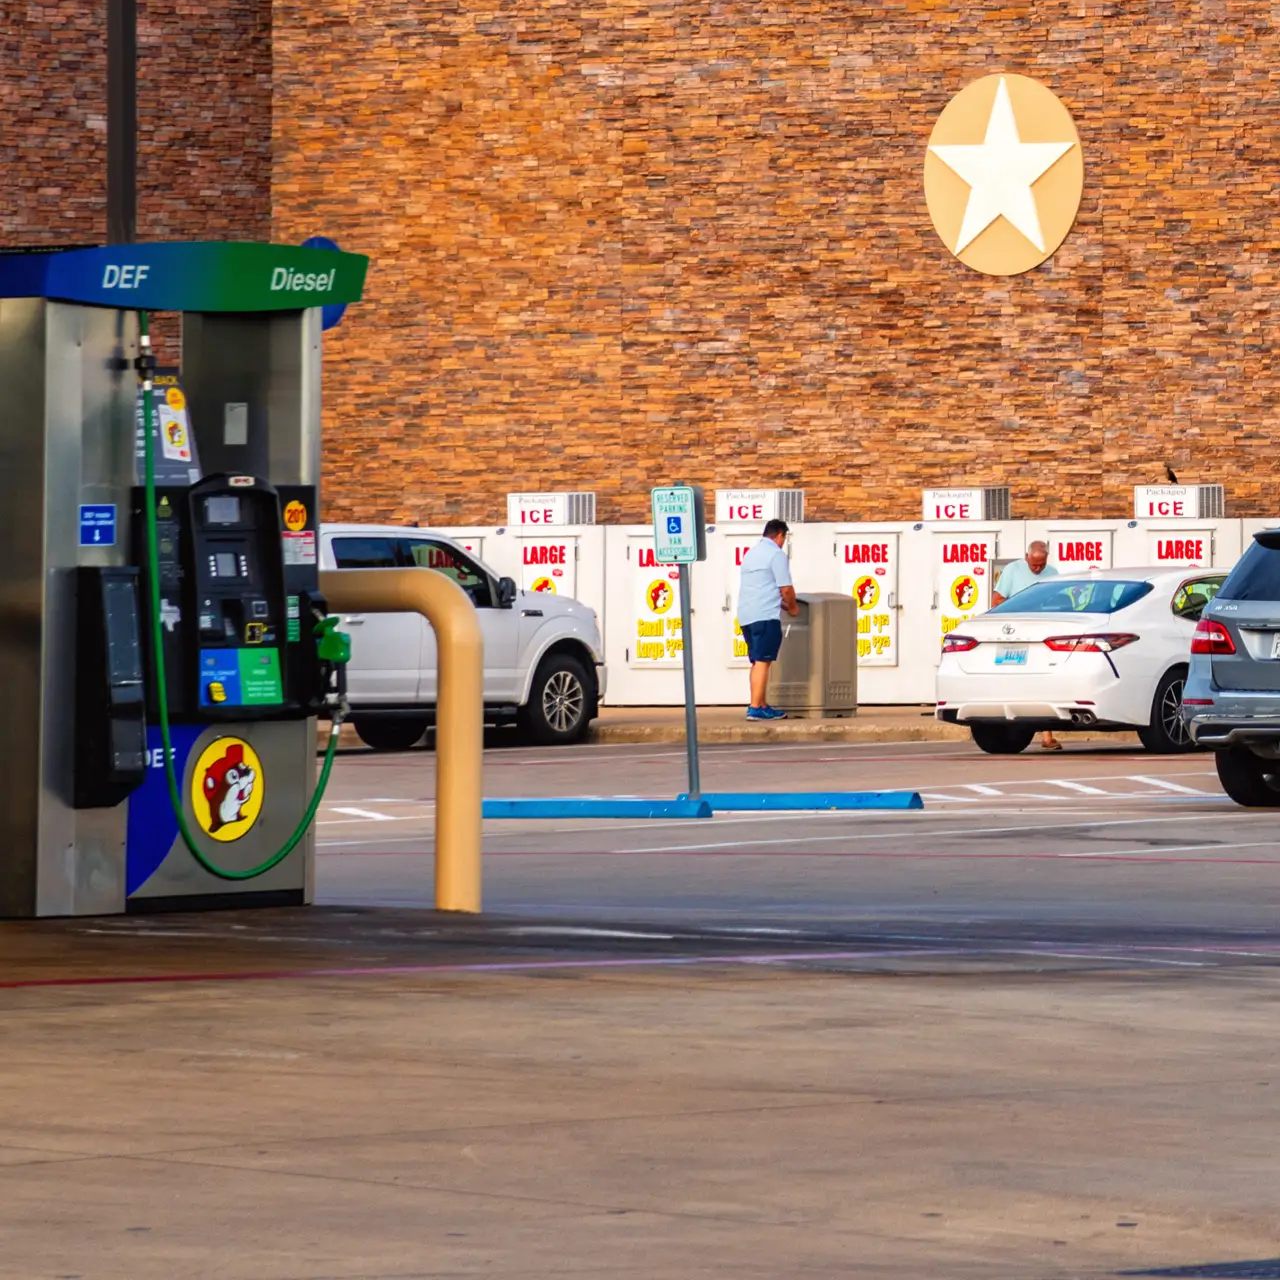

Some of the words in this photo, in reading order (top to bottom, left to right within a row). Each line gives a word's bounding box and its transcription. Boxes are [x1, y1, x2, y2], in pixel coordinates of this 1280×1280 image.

[102, 265, 149, 288] DEF
[270, 267, 335, 291] Diesel
[656, 493, 688, 503] RESERVED
[287, 508, 306, 523] 201
[521, 509, 553, 523] ICE
[659, 504, 687, 513] PARKING
[729, 505, 763, 519] ICE
[936, 504, 970, 518] ICE
[1149, 501, 1184, 516] ICE
[669, 536, 681, 545] VAN
[523, 545, 566, 565] LARGE
[658, 547, 693, 557] ACCESSIBLE
[844, 544, 889, 564] LARGE
[943, 543, 988, 563] LARGE
[1058, 541, 1103, 561] LARGE
[1157, 539, 1203, 560] LARGE
[637, 618, 664, 637] Small
[636, 639, 664, 660] Large
